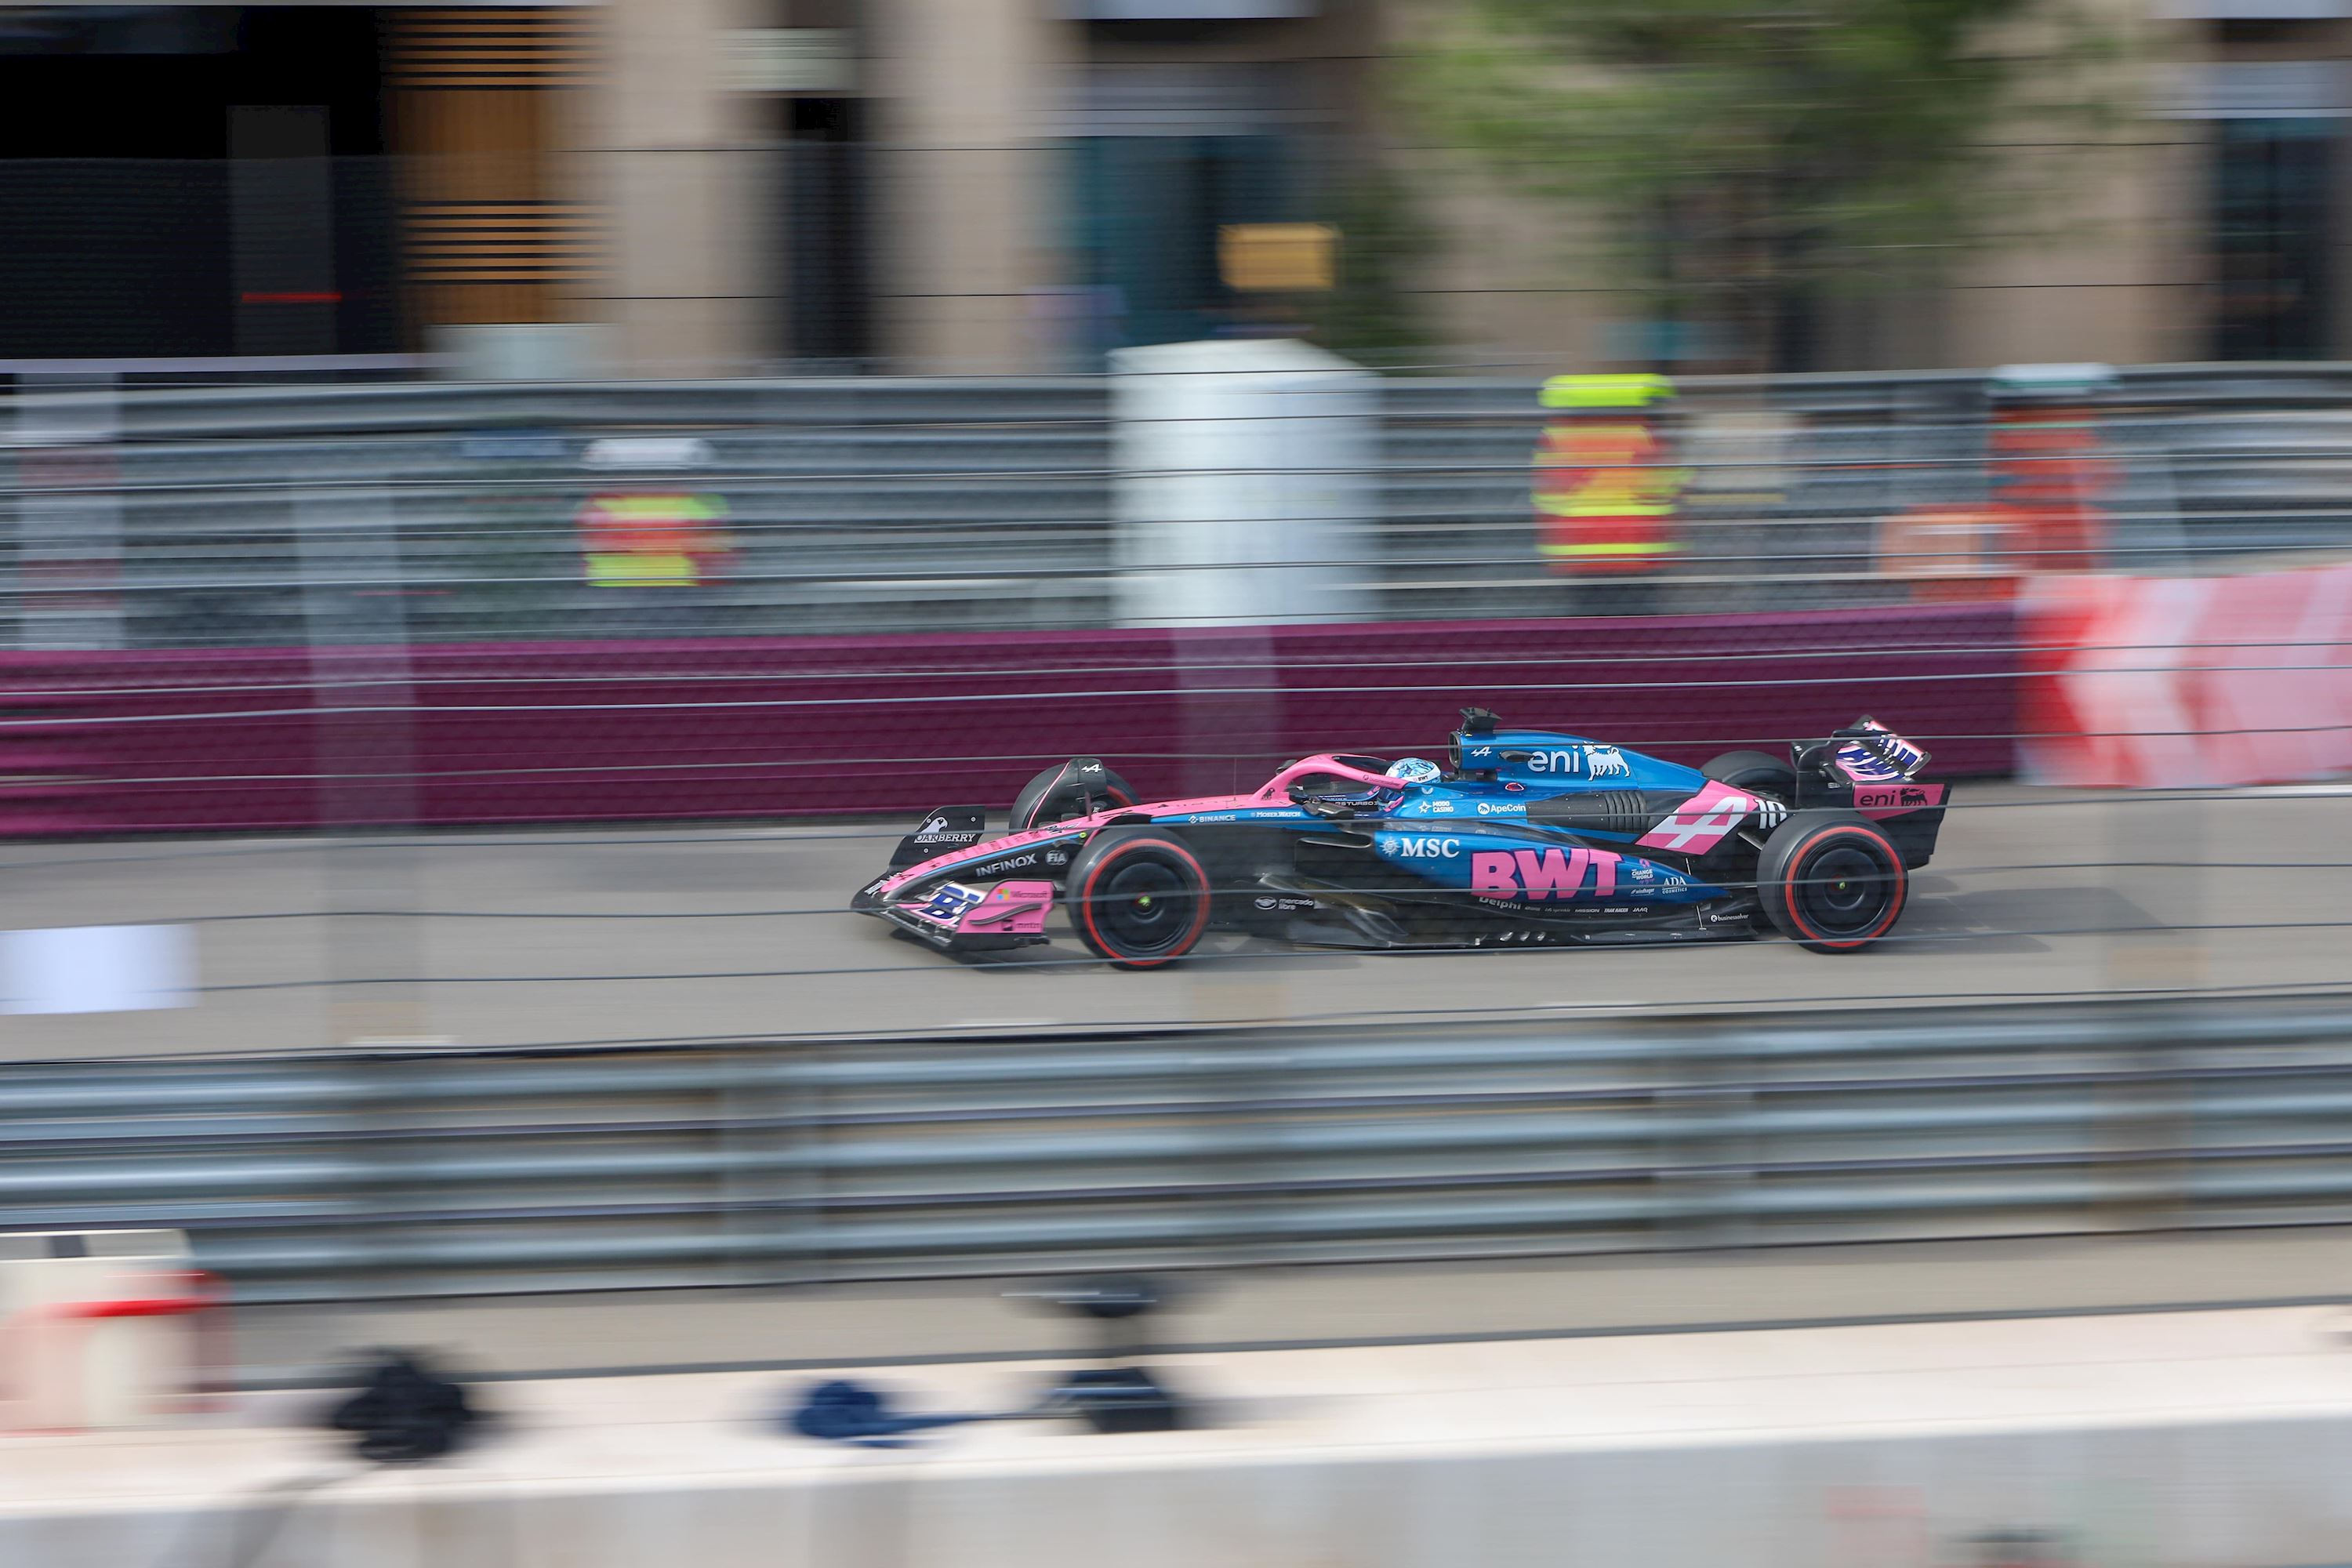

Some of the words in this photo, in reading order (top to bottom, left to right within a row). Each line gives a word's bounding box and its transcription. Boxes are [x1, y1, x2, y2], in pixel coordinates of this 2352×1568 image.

[1527, 745, 1580, 772] eni
[1860, 790, 1896, 806] eni
[1490, 804, 1526, 814] ApeCoin
[914, 833, 976, 844] OAKBERRY
[1401, 838, 1460, 858] MSC
[975, 853, 1037, 877] INFINOX
[1471, 848, 1623, 900] BWT
[1664, 876, 1687, 886] ADA
